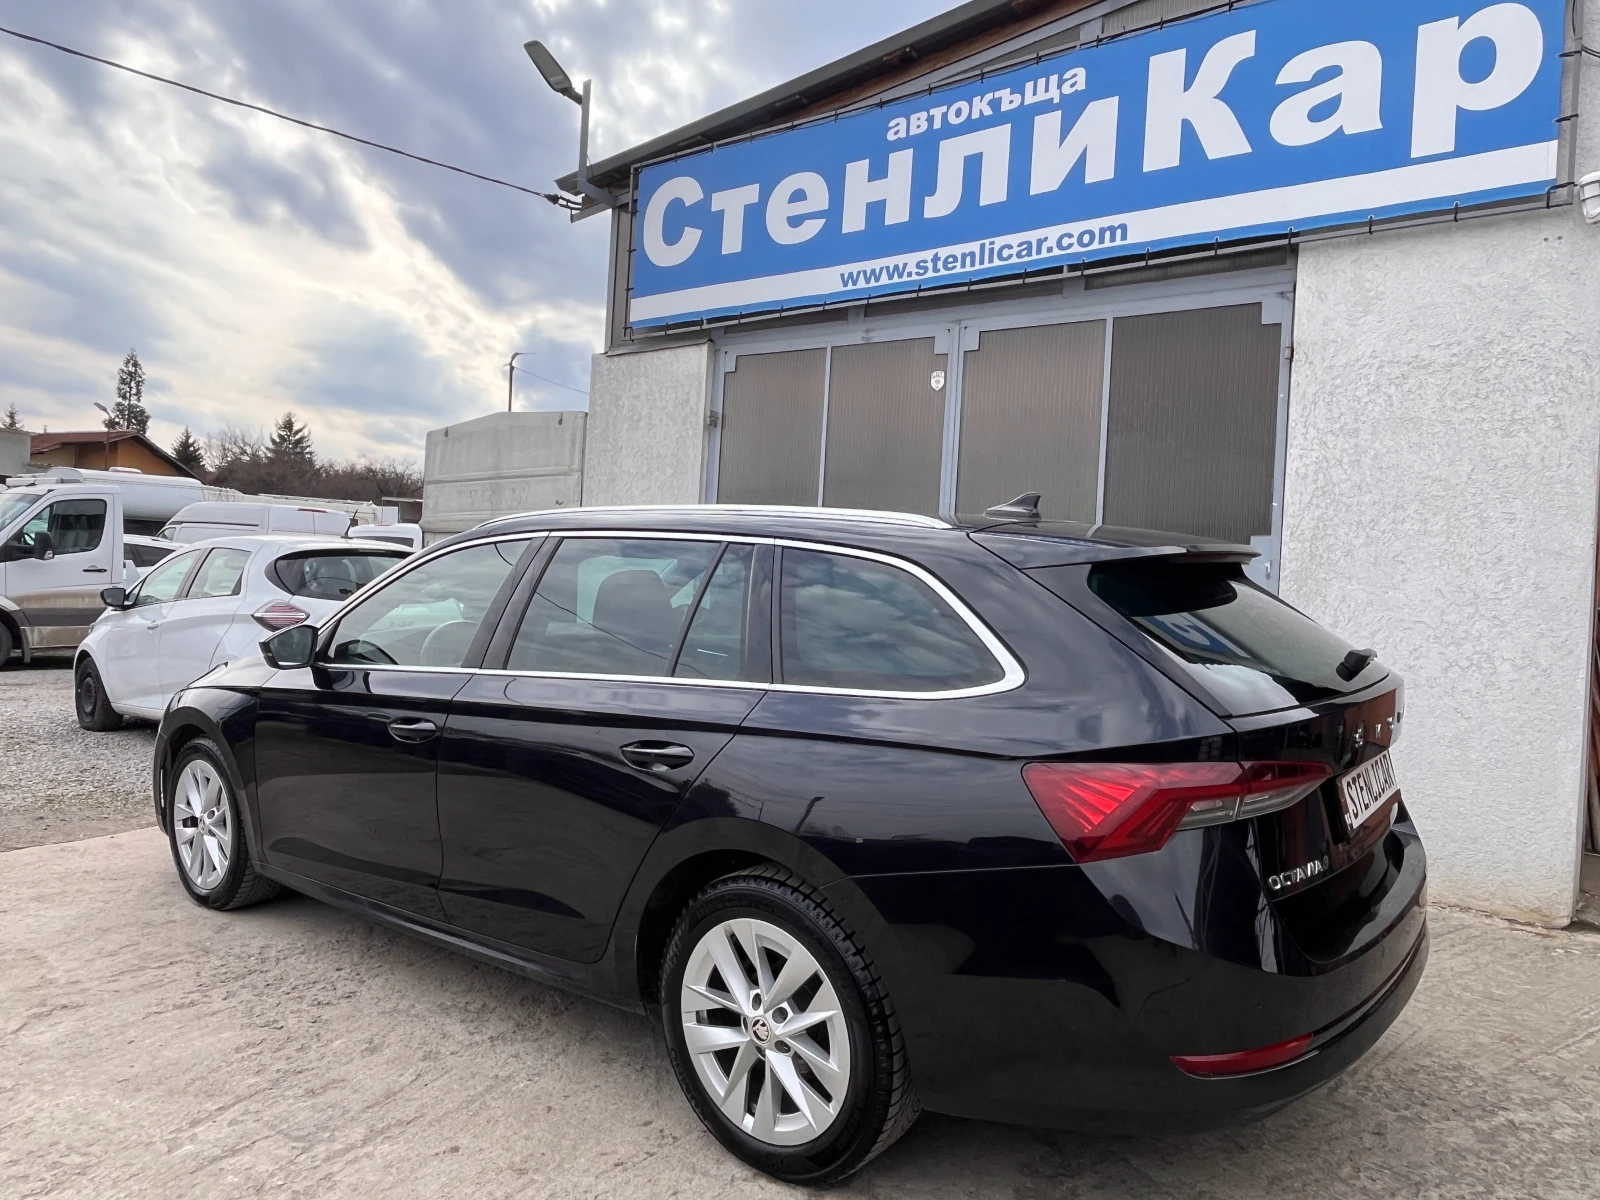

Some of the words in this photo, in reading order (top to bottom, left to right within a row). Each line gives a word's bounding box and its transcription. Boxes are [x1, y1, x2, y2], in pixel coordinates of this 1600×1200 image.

[642, 2, 1543, 268] СтенлиКар
[886, 66, 1087, 141] автокъща
[839, 222, 1128, 289] www.stenlicar.com
[1346, 754, 1395, 820] STENLICAR
[1268, 860, 1323, 890] OCTAVIA
